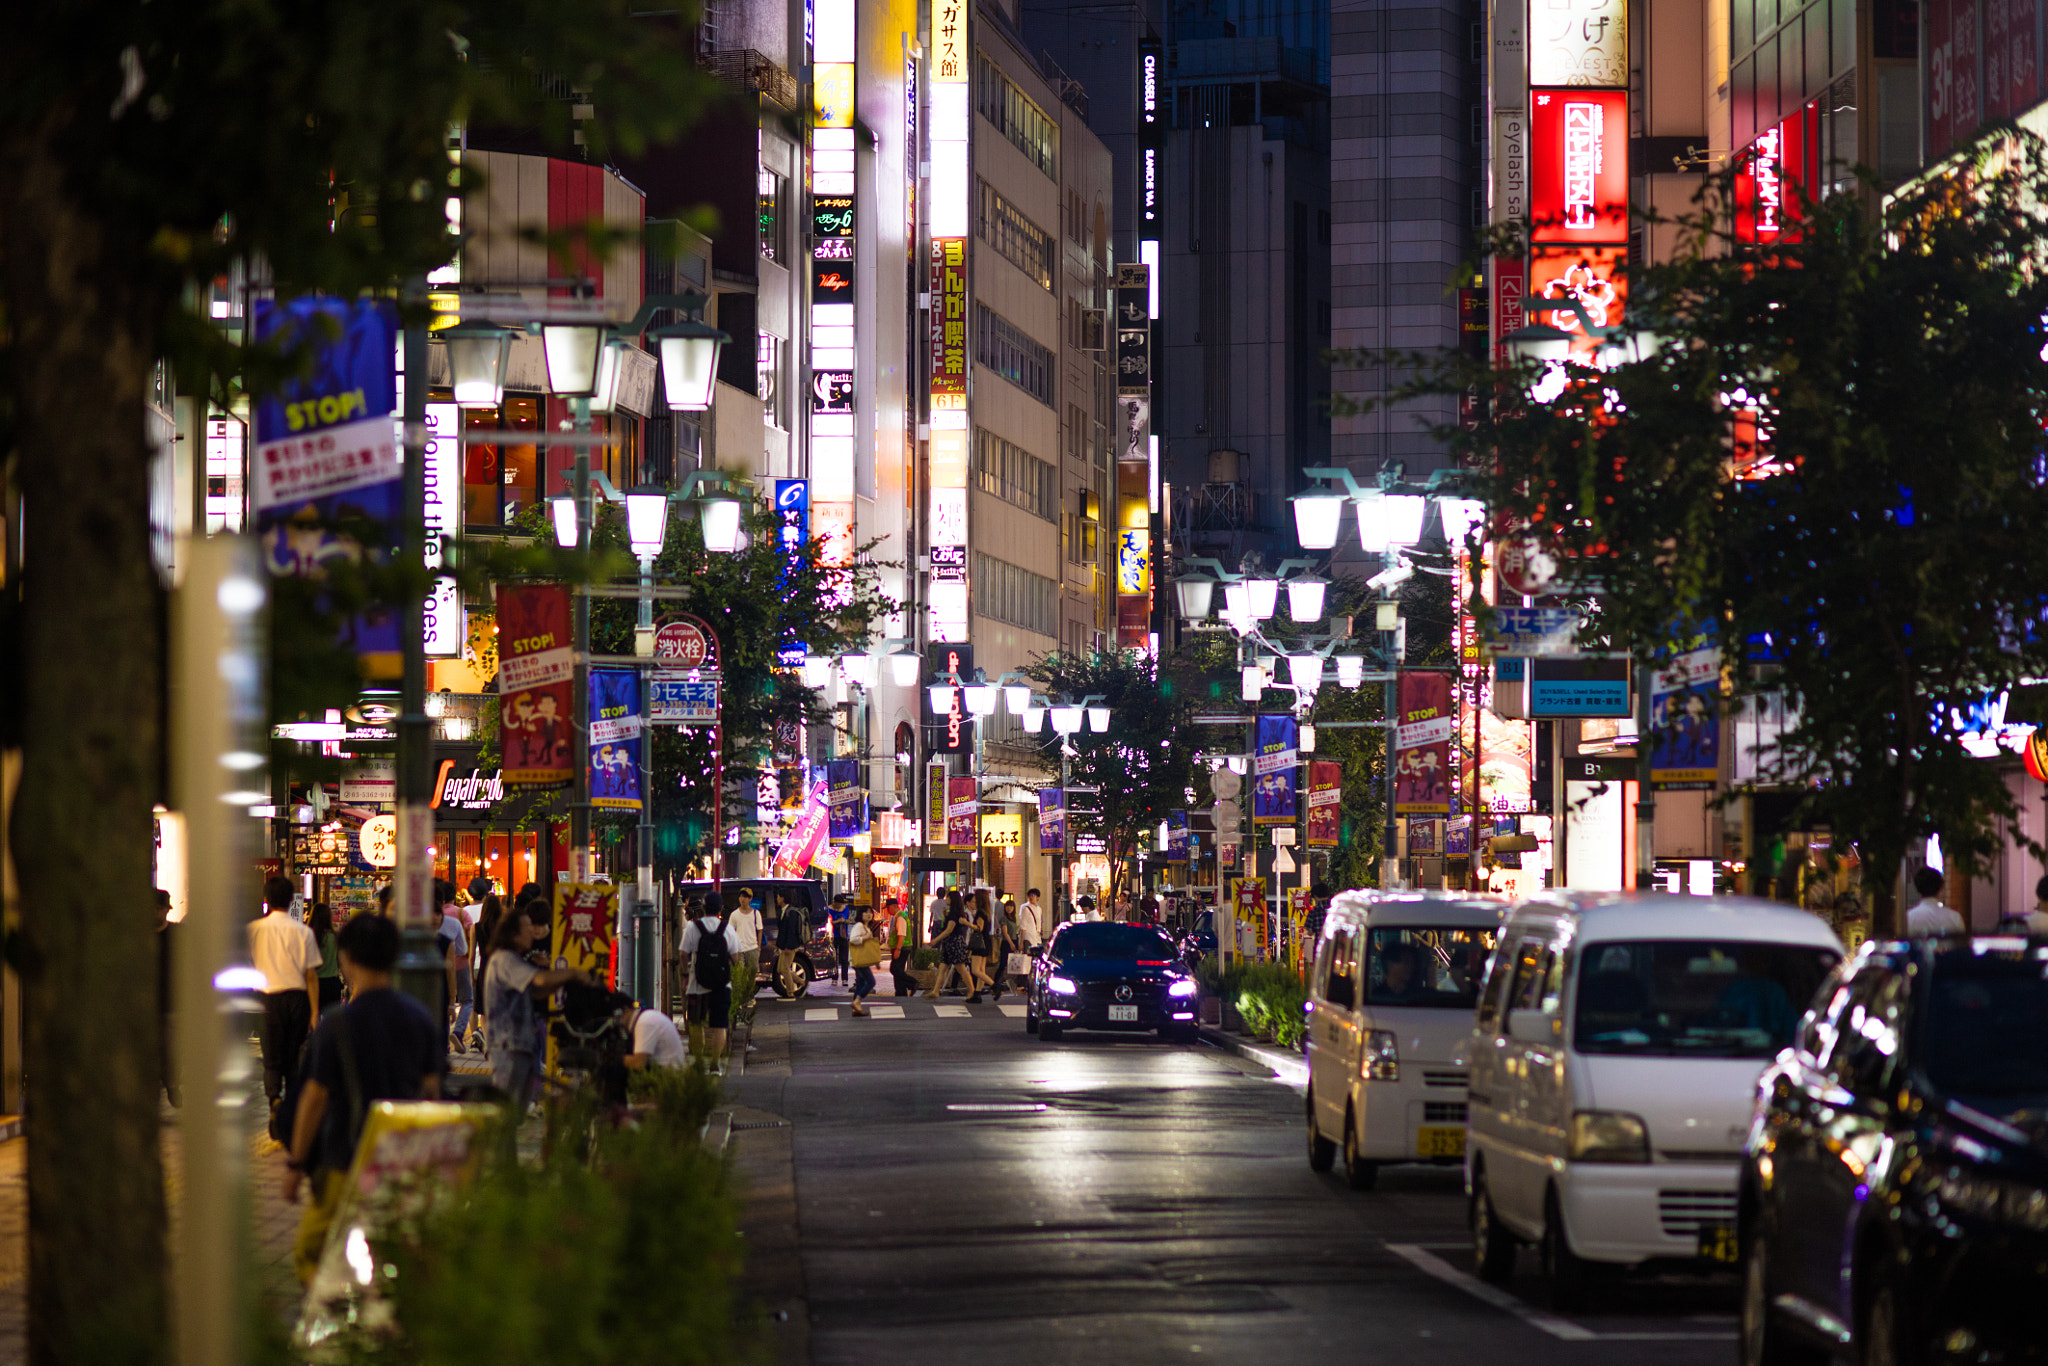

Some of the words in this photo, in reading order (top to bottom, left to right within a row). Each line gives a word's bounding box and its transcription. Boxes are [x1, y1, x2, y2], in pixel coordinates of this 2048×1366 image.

[1538, 95, 1551, 106] 3F
[1503, 121, 1524, 191] eyelash
[944, 240, 965, 375] まんが喫茶
[286, 388, 366, 432] STOP!
[513, 631, 555, 655] STOP!
[658, 638, 701, 659] 消火栓
[600, 705, 629, 719] STOP!
[1407, 706, 1439, 722] STOP!
[1263, 741, 1287, 754] STOP!
[931, 767, 943, 821] まんが喫茶
[1315, 782, 1334, 791] STOP!
[462, 800, 491, 809] ZANETTI
[954, 795, 970, 803] STOP!
[373, 823, 386, 861] らーめん
